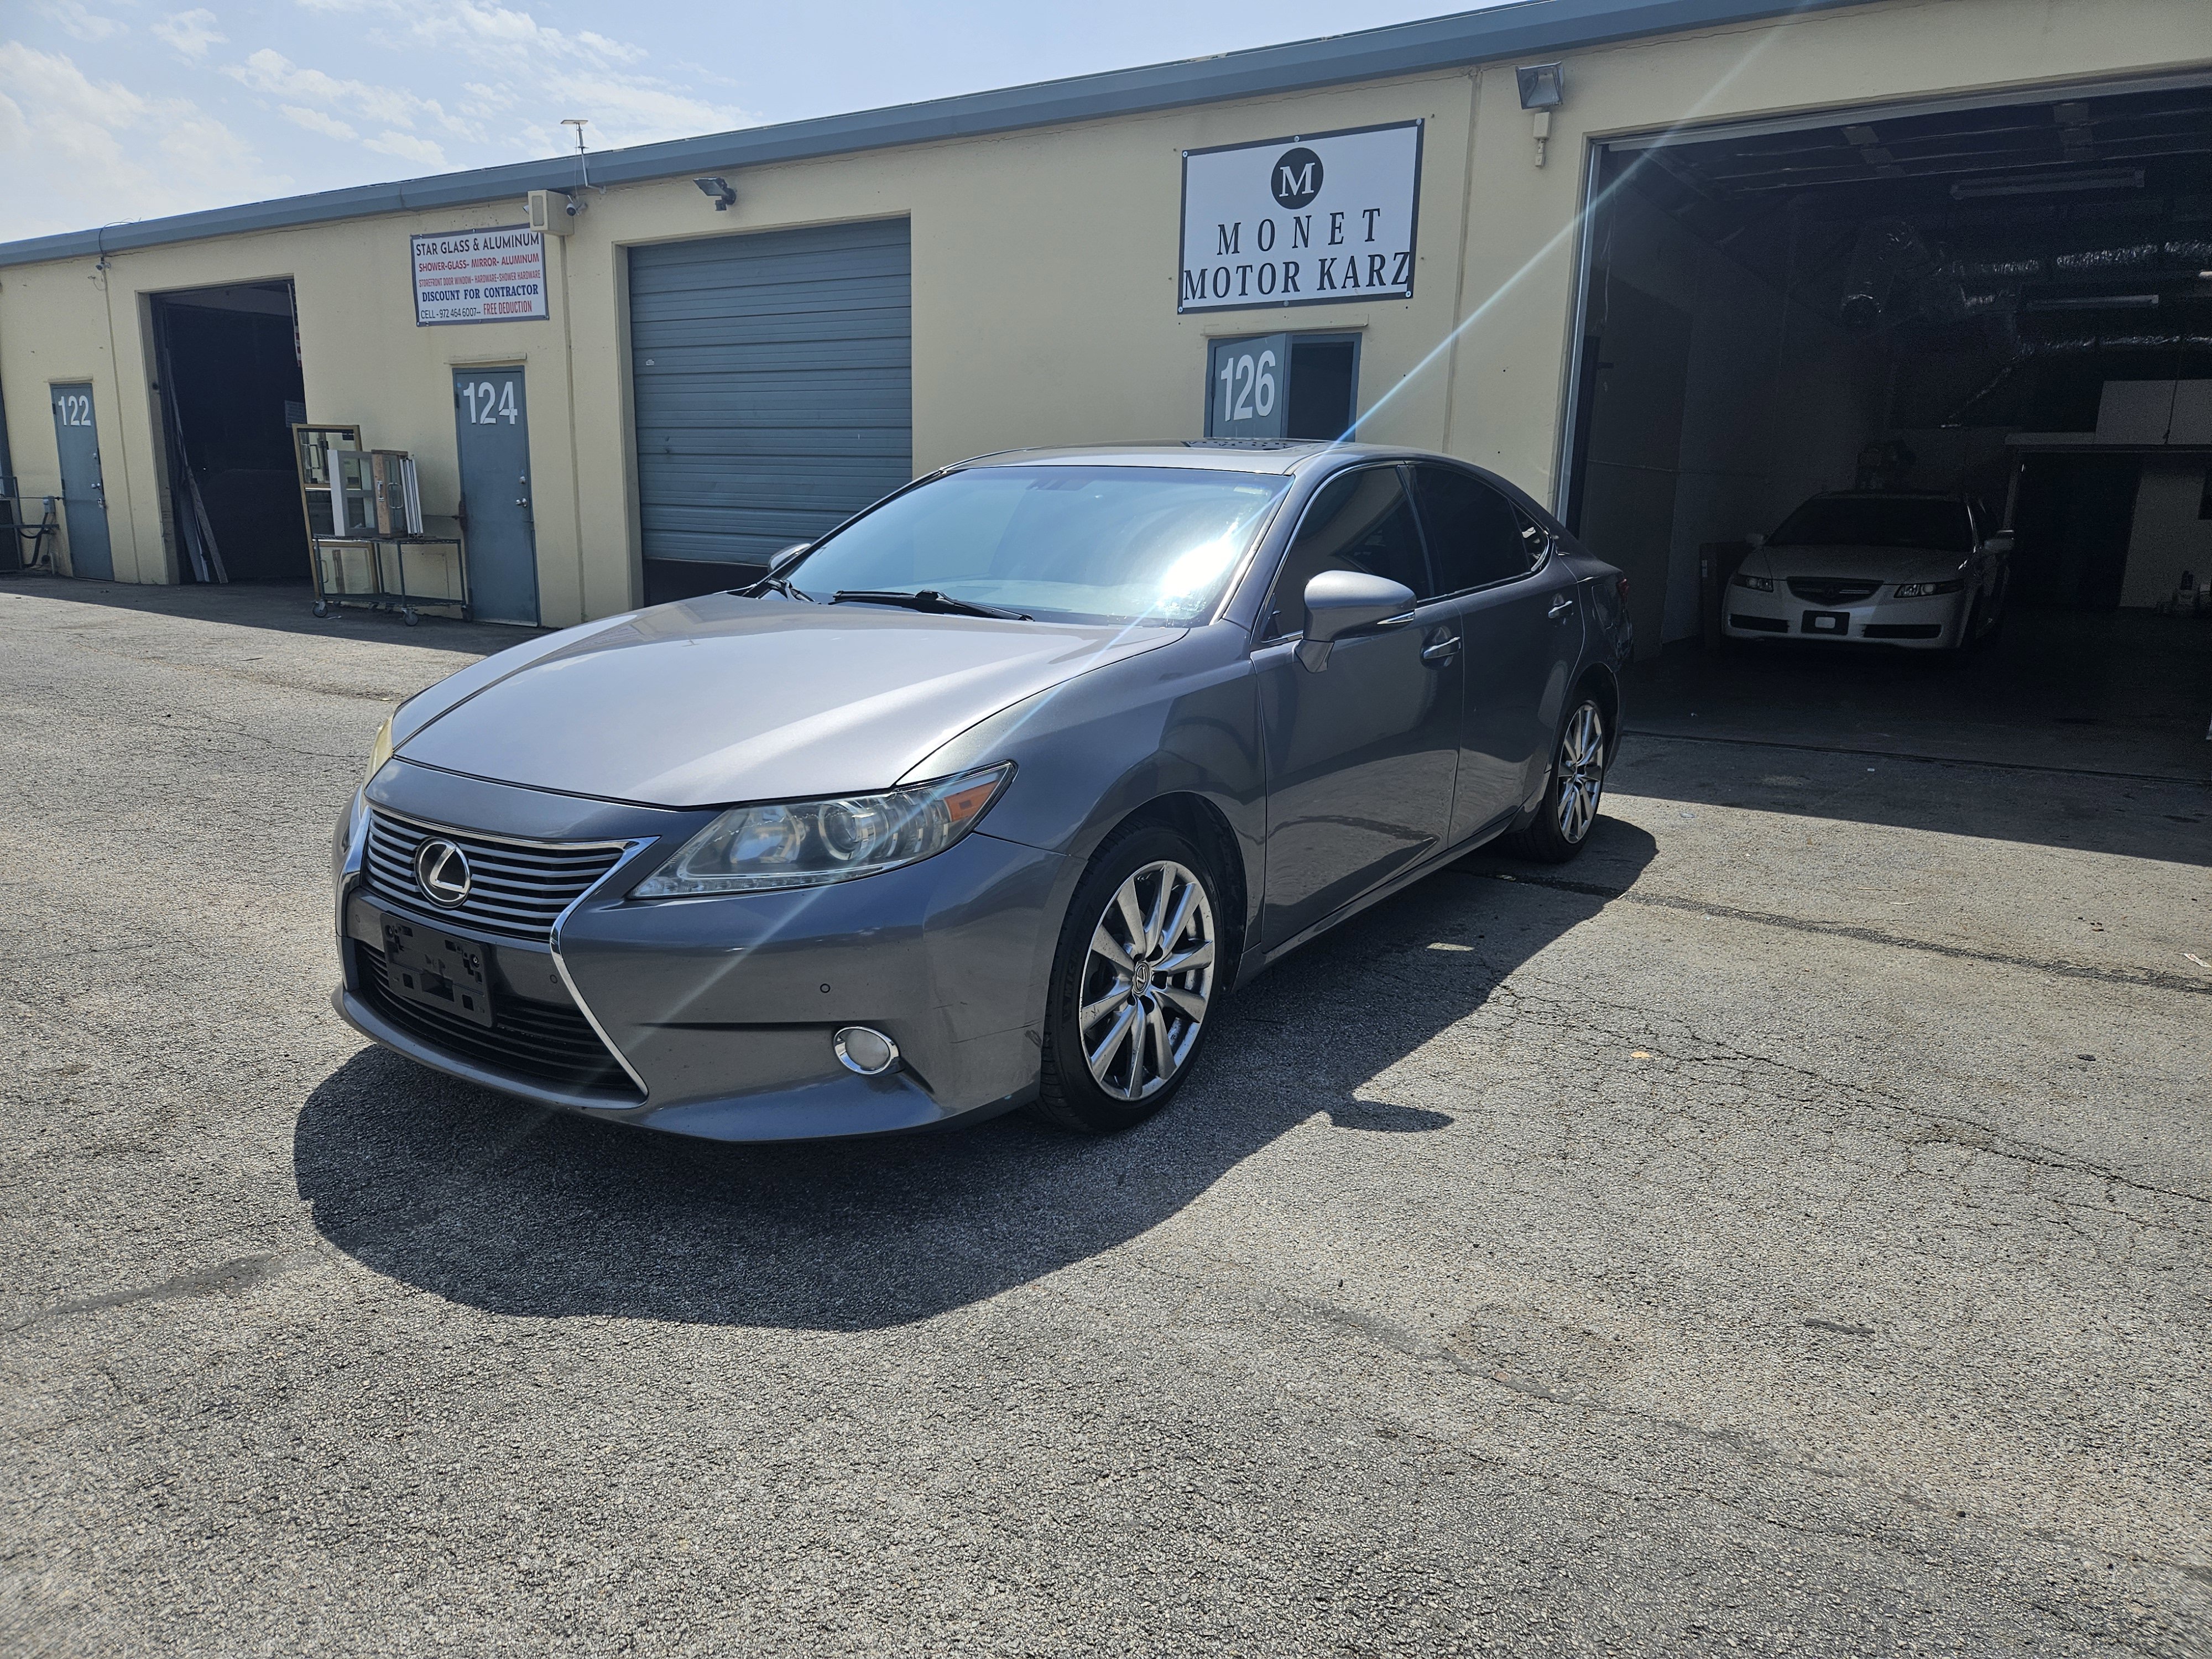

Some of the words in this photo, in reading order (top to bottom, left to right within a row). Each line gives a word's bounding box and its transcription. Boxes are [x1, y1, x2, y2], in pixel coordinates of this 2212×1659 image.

[1279, 163, 1315, 197] M
[416, 243, 438, 256] STAR
[441, 239, 469, 254] GLASS
[473, 238, 479, 251] &
[483, 232, 539, 250] ALUMINUM
[1217, 208, 1380, 255] MONET
[502, 253, 539, 265] ALUMINUM
[419, 278, 442, 287] STOREFRONT
[443, 277, 454, 285] DOOR
[517, 270, 540, 280] HARDWARE
[1183, 261, 1300, 300] MOTOR
[1317, 252, 1410, 291] KARZ
[422, 290, 460, 302] DISCOUNT
[464, 289, 480, 299] FOR
[484, 284, 539, 298] CONTRACTOR
[483, 302, 497, 315] FREE
[498, 300, 532, 314] DEDUCTION
[1220, 350, 1276, 421] 126
[58, 395, 91, 426] 122
[463, 382, 518, 425] 124
